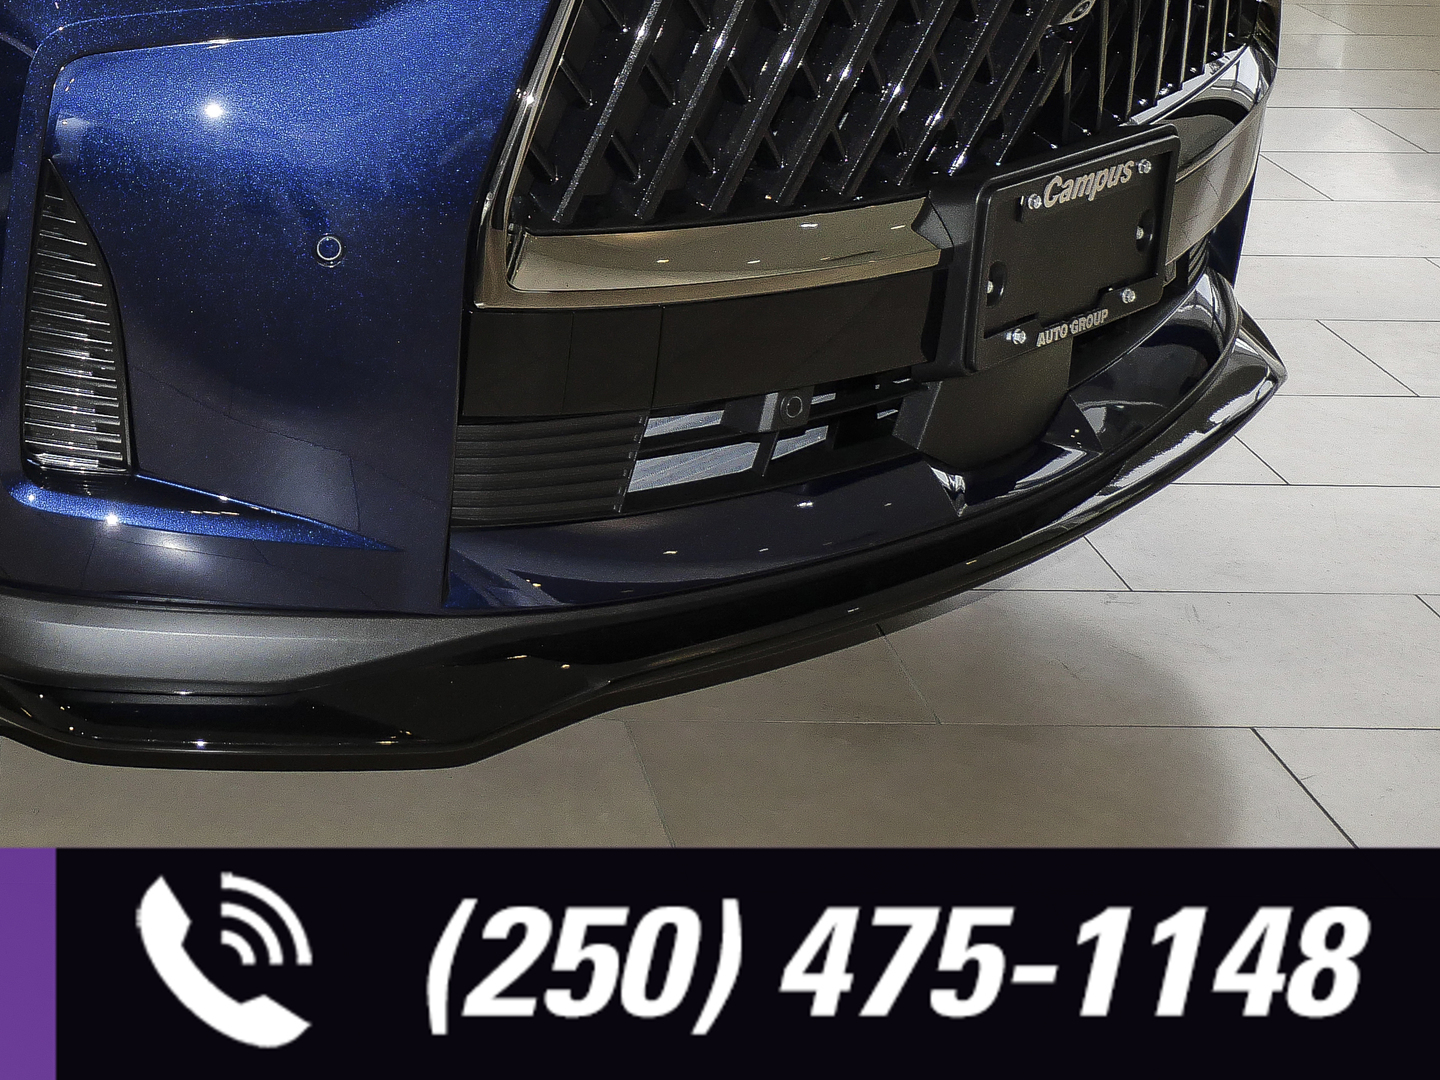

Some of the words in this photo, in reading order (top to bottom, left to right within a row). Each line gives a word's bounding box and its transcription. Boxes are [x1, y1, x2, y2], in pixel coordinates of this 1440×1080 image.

[1043, 160, 1136, 209] Campus
[1036, 323, 1069, 348] AUTO
[1070, 308, 1109, 336] GROUP
